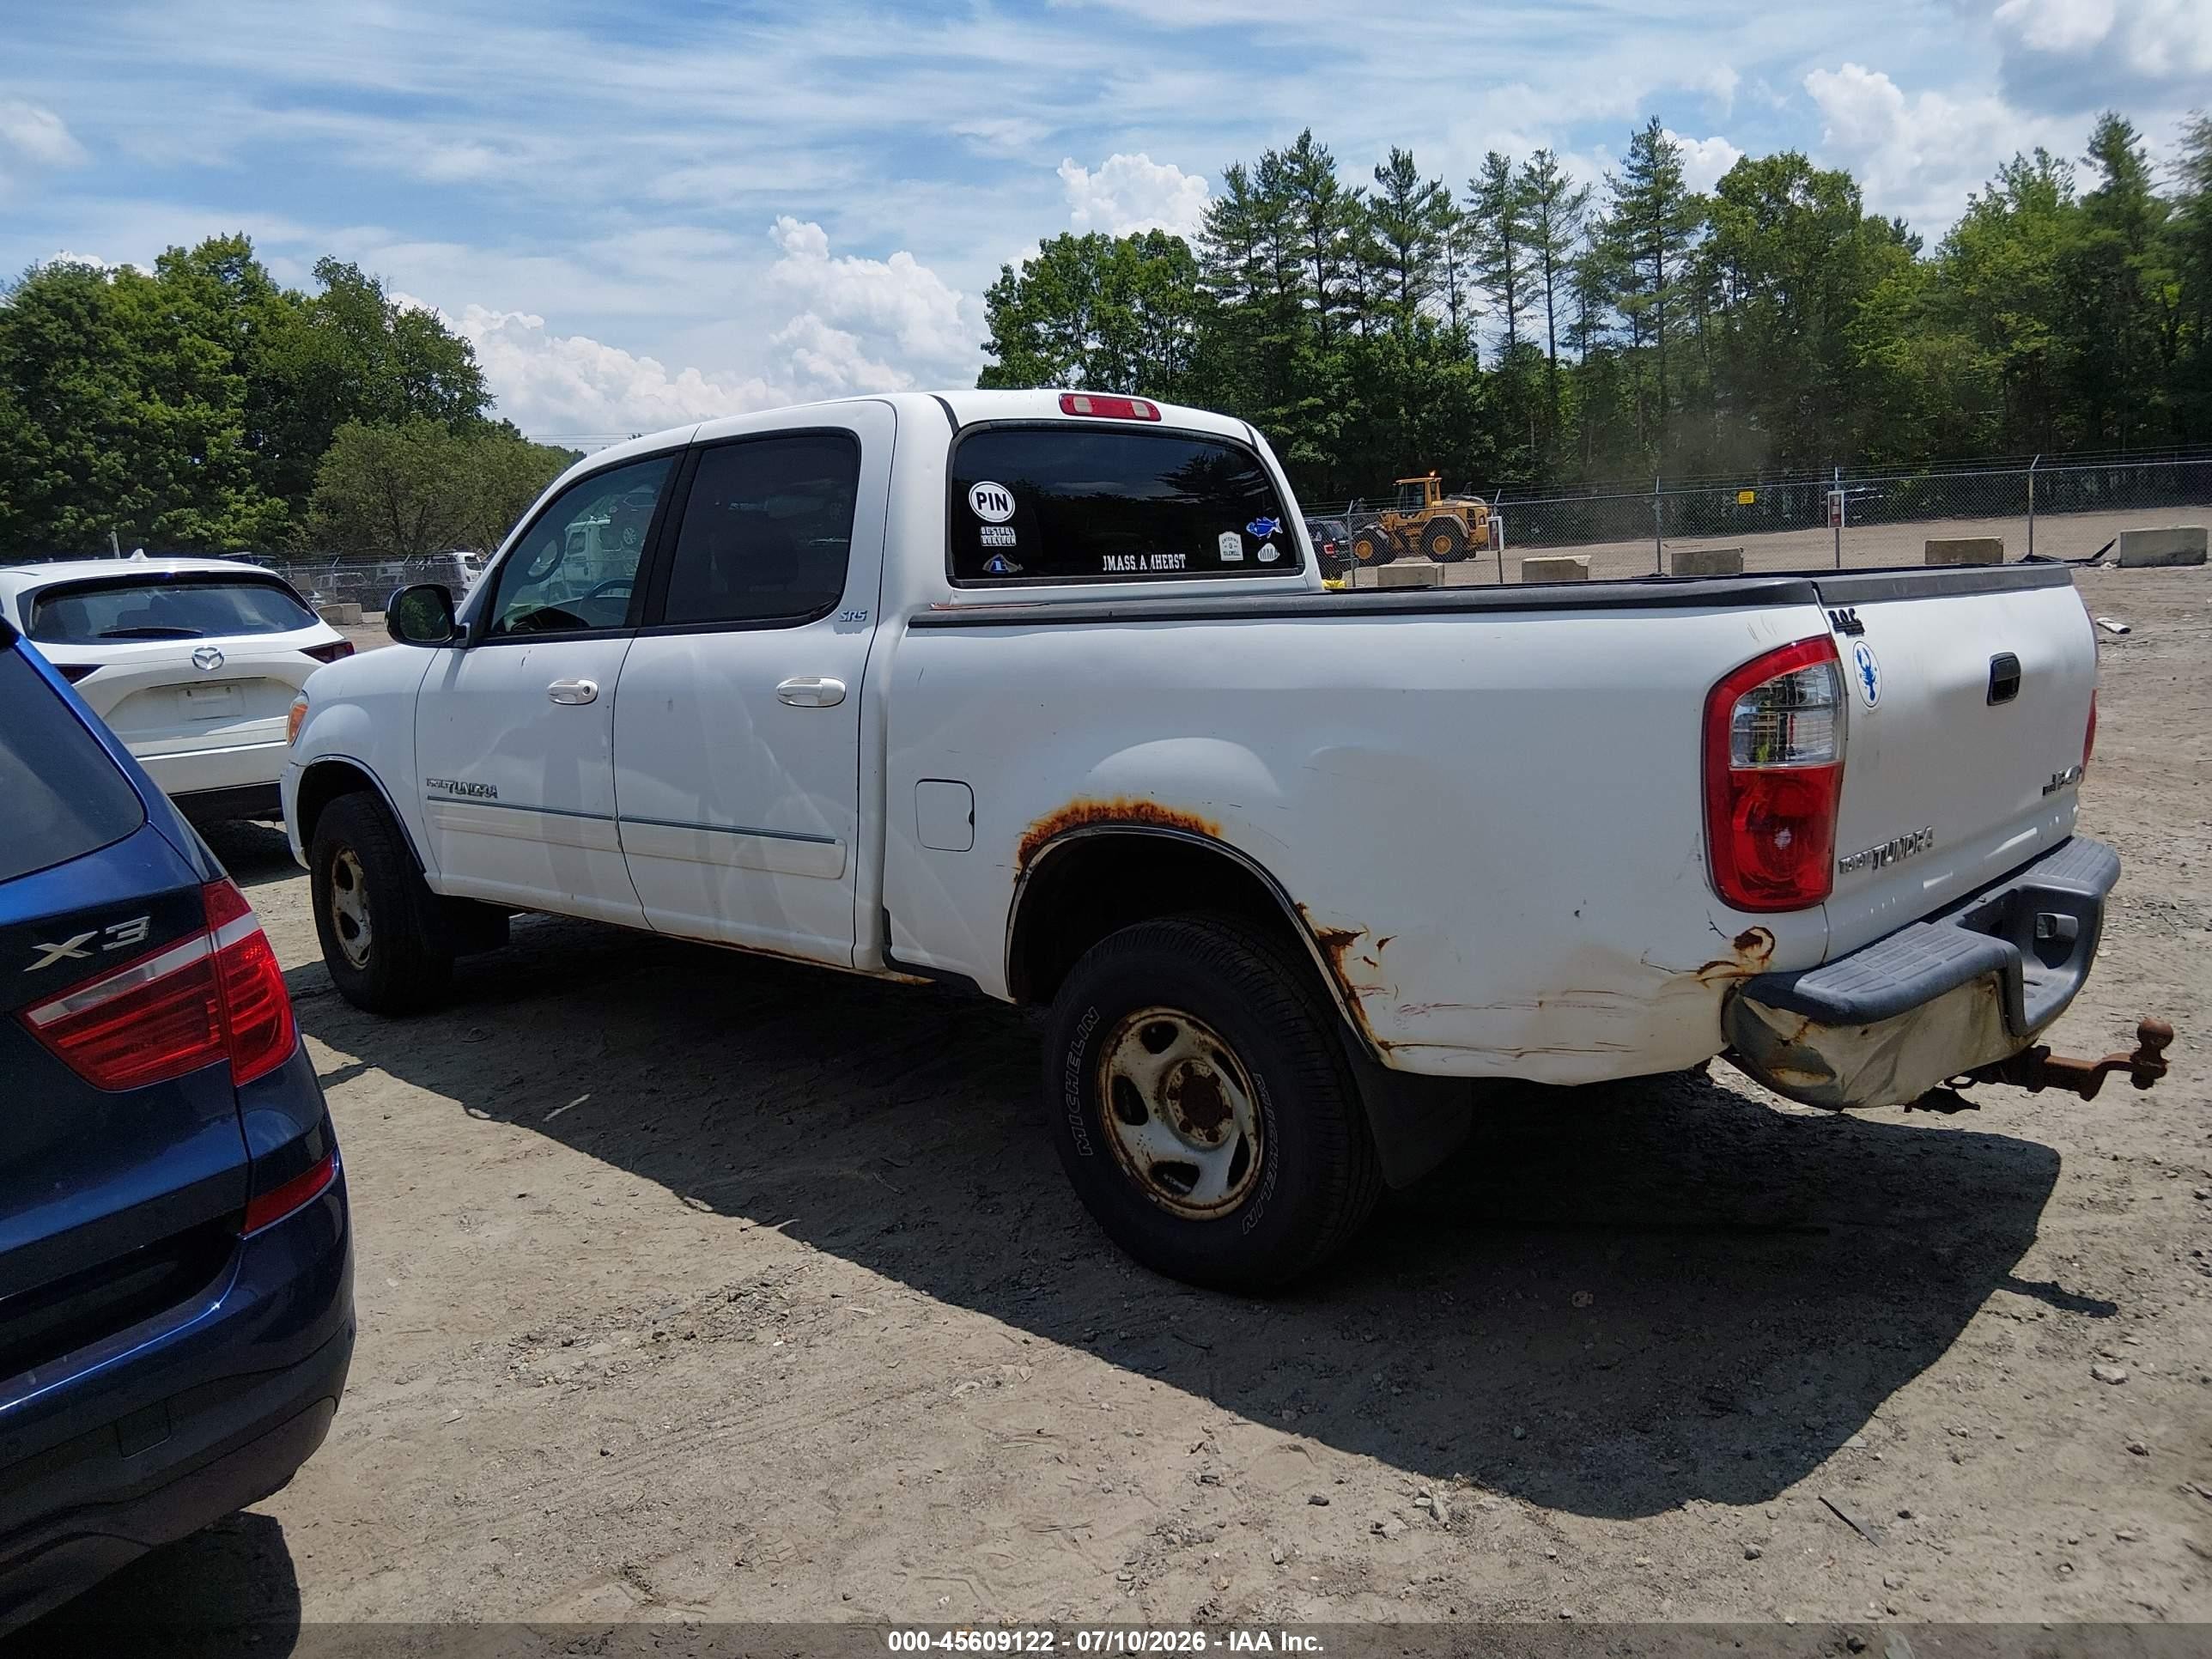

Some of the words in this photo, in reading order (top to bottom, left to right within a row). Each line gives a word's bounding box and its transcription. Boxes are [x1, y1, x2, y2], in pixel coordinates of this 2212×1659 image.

[975, 492, 1009, 512] PIN
[981, 526, 1015, 536] DESTROY
[839, 611, 868, 623] SR5
[447, 781, 498, 799] TUNDRA
[1872, 825, 1934, 871] TUNDRA
[22, 915, 150, 972] X3
[1065, 1006, 1100, 1157] MICHELIN
[1242, 1073, 1279, 1235] MICHELIN
